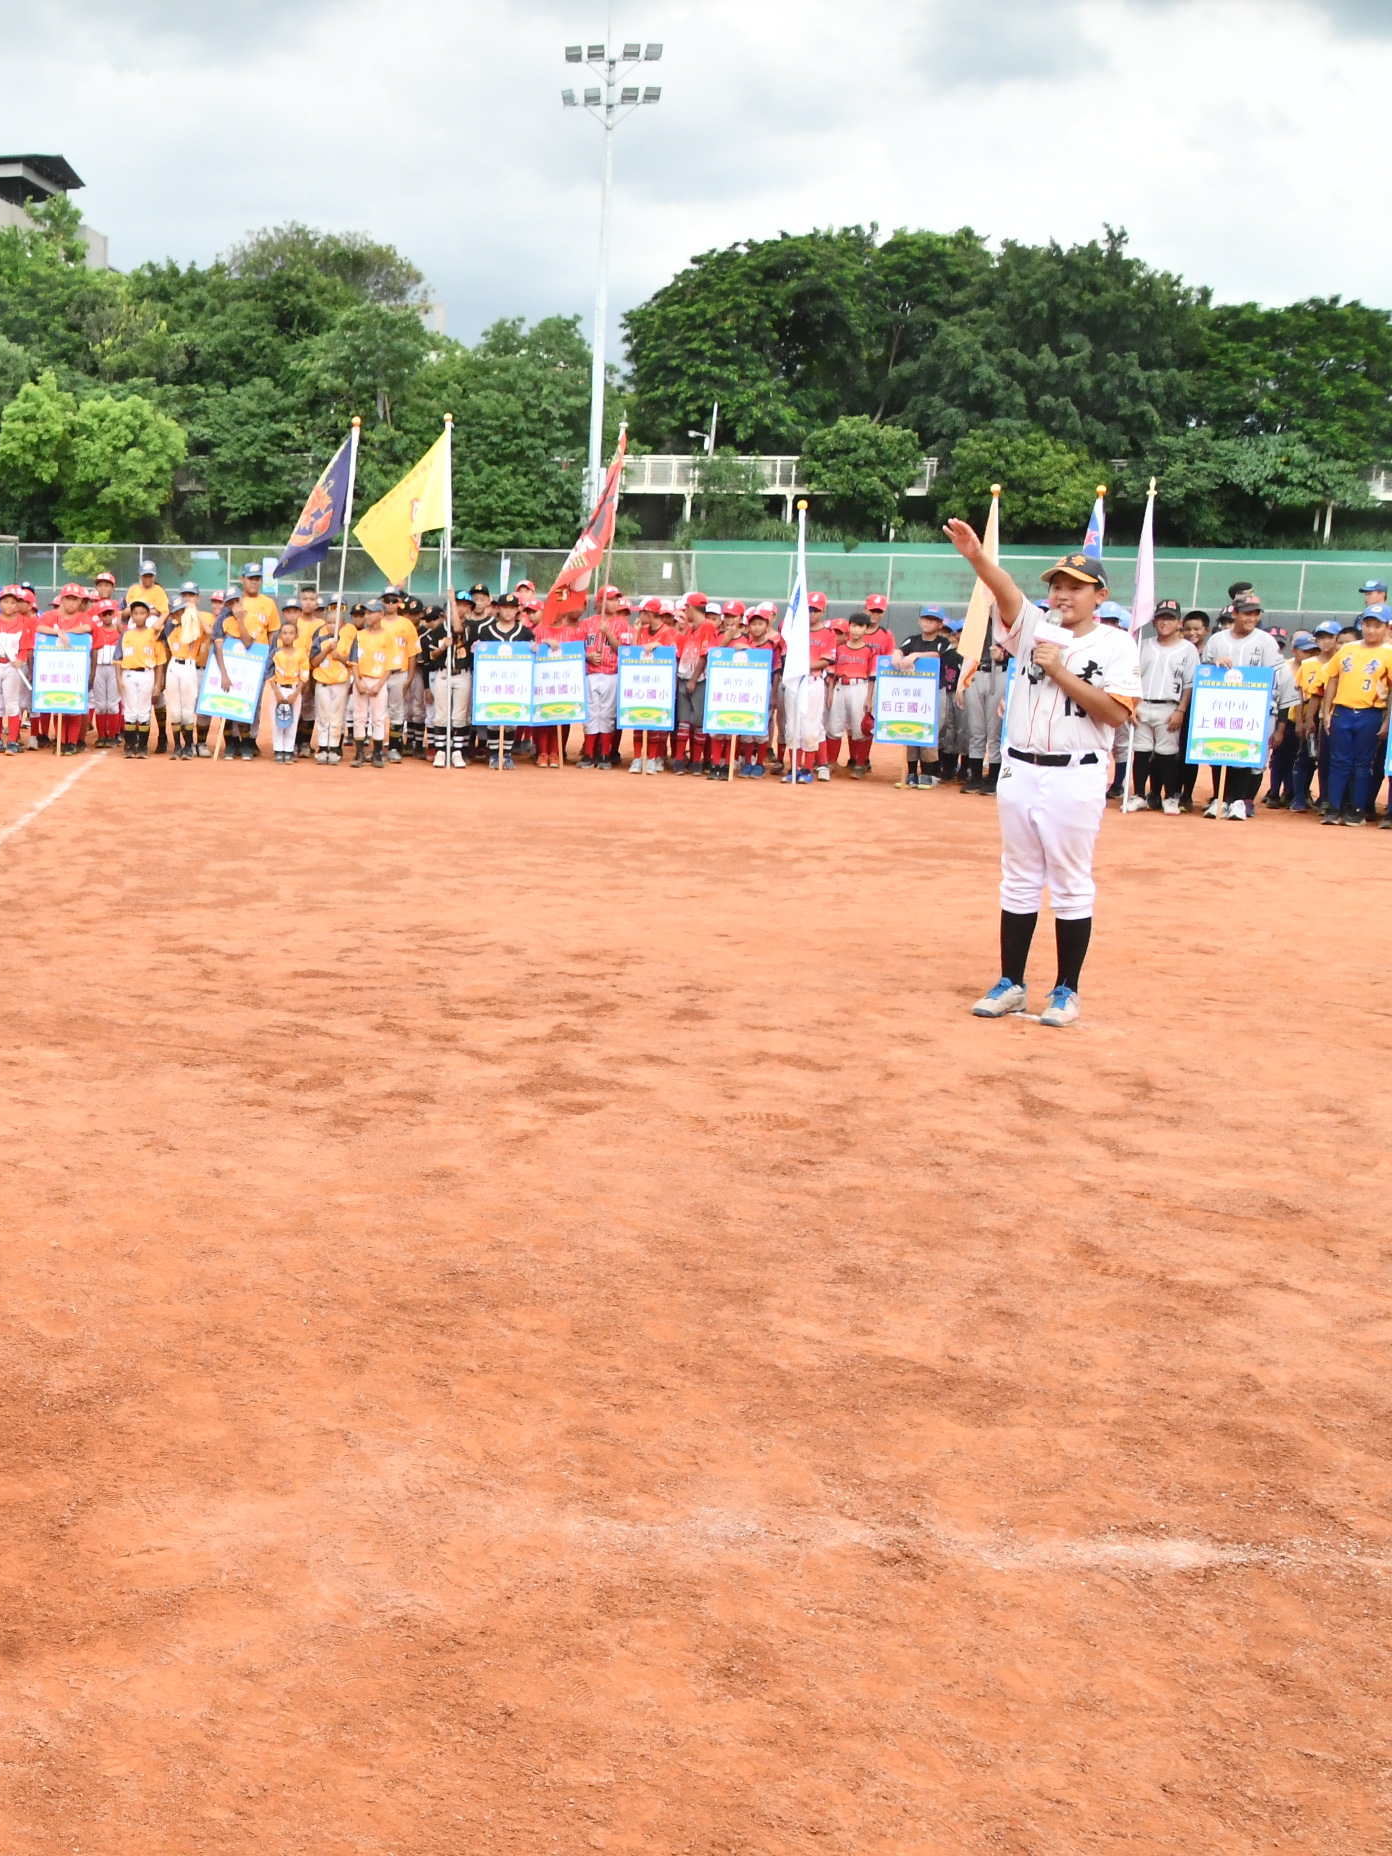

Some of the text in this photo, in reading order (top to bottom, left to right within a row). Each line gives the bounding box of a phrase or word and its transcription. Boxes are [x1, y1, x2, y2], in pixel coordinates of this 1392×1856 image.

[39, 673, 83, 685] 東園國小
[490, 670, 518, 679] 新北市
[542, 670, 571, 680] 新北市
[632, 674, 660, 684] 桃園市
[209, 676, 254, 694] 龍國小
[723, 677, 754, 686] 新竹市
[1362, 679, 1372, 691] 3
[479, 683, 528, 695] 中港國小
[534, 684, 581, 696] 新埔國小
[891, 687, 922, 698] 苗栗縣
[1173, 682, 1181, 694] 3
[712, 691, 763, 704] 建功國小
[880, 701, 931, 714] 后庄國小
[1211, 699, 1250, 711] 台中市
[1197, 715, 1260, 731] 上楓國小
